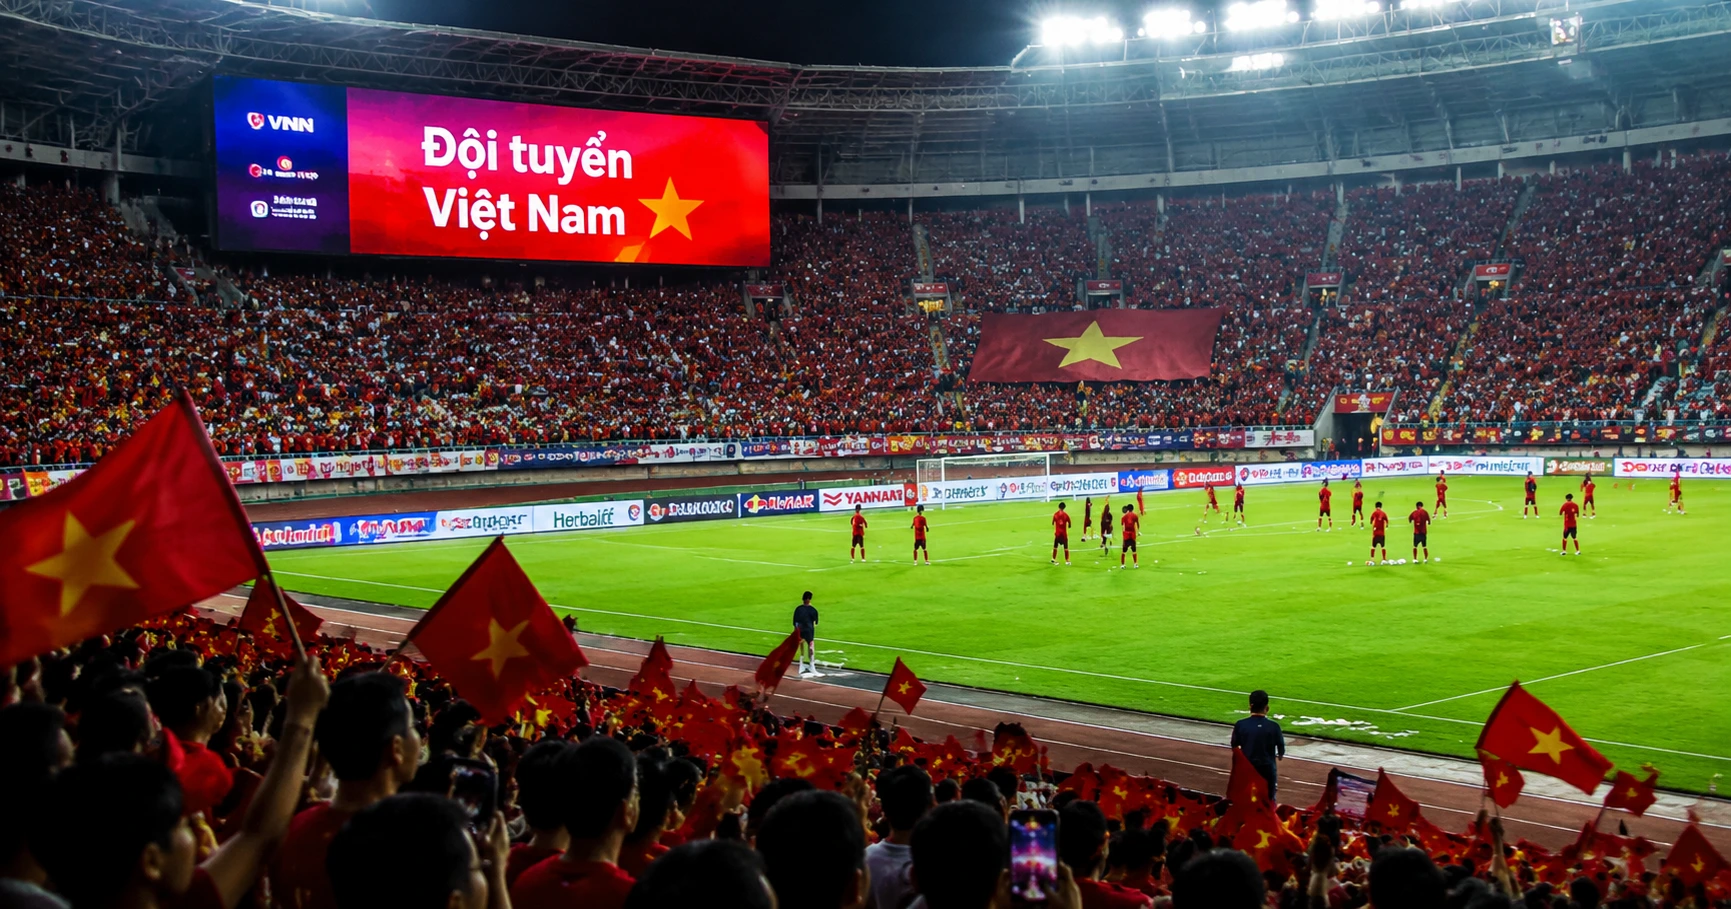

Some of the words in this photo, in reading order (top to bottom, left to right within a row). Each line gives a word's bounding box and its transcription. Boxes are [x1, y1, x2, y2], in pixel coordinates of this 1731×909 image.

[267, 114, 314, 133] VNN
[421, 126, 498, 180] Đội
[509, 130, 633, 186] tuyển
[422, 186, 517, 241] Việt
[528, 193, 626, 236] Nam
